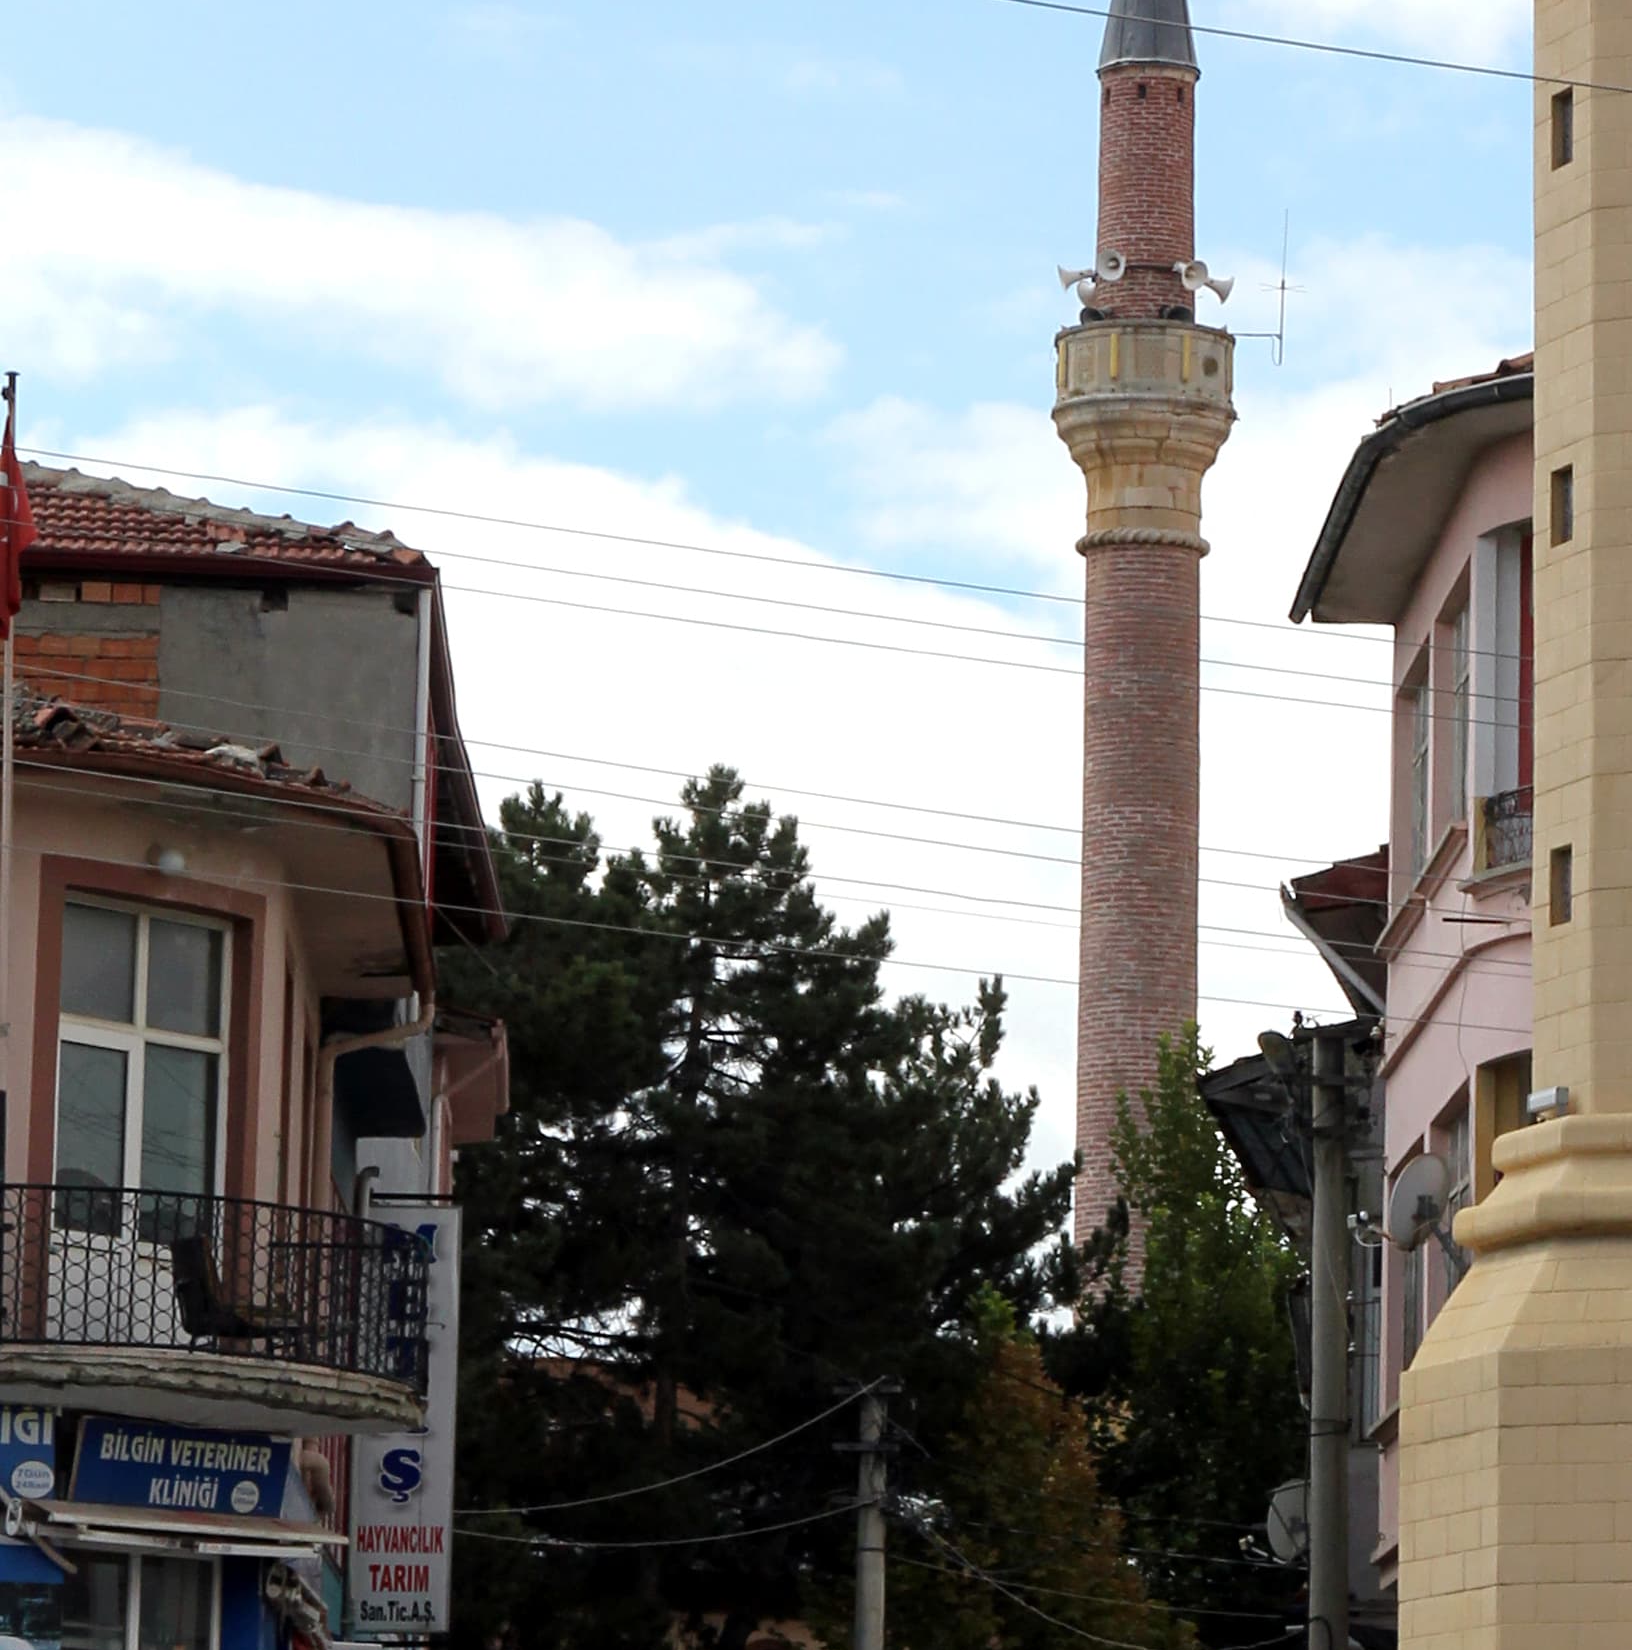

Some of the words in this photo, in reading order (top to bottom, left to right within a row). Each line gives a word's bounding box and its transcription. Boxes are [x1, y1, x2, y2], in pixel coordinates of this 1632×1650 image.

[100, 1428, 165, 1464] BİLGİN
[171, 1438, 272, 1475] VETERİNER
[149, 1473, 219, 1509] KLİNİĞİ
[357, 1525, 444, 1553] HAYVANCILIK
[369, 1564, 429, 1592] TARIM
